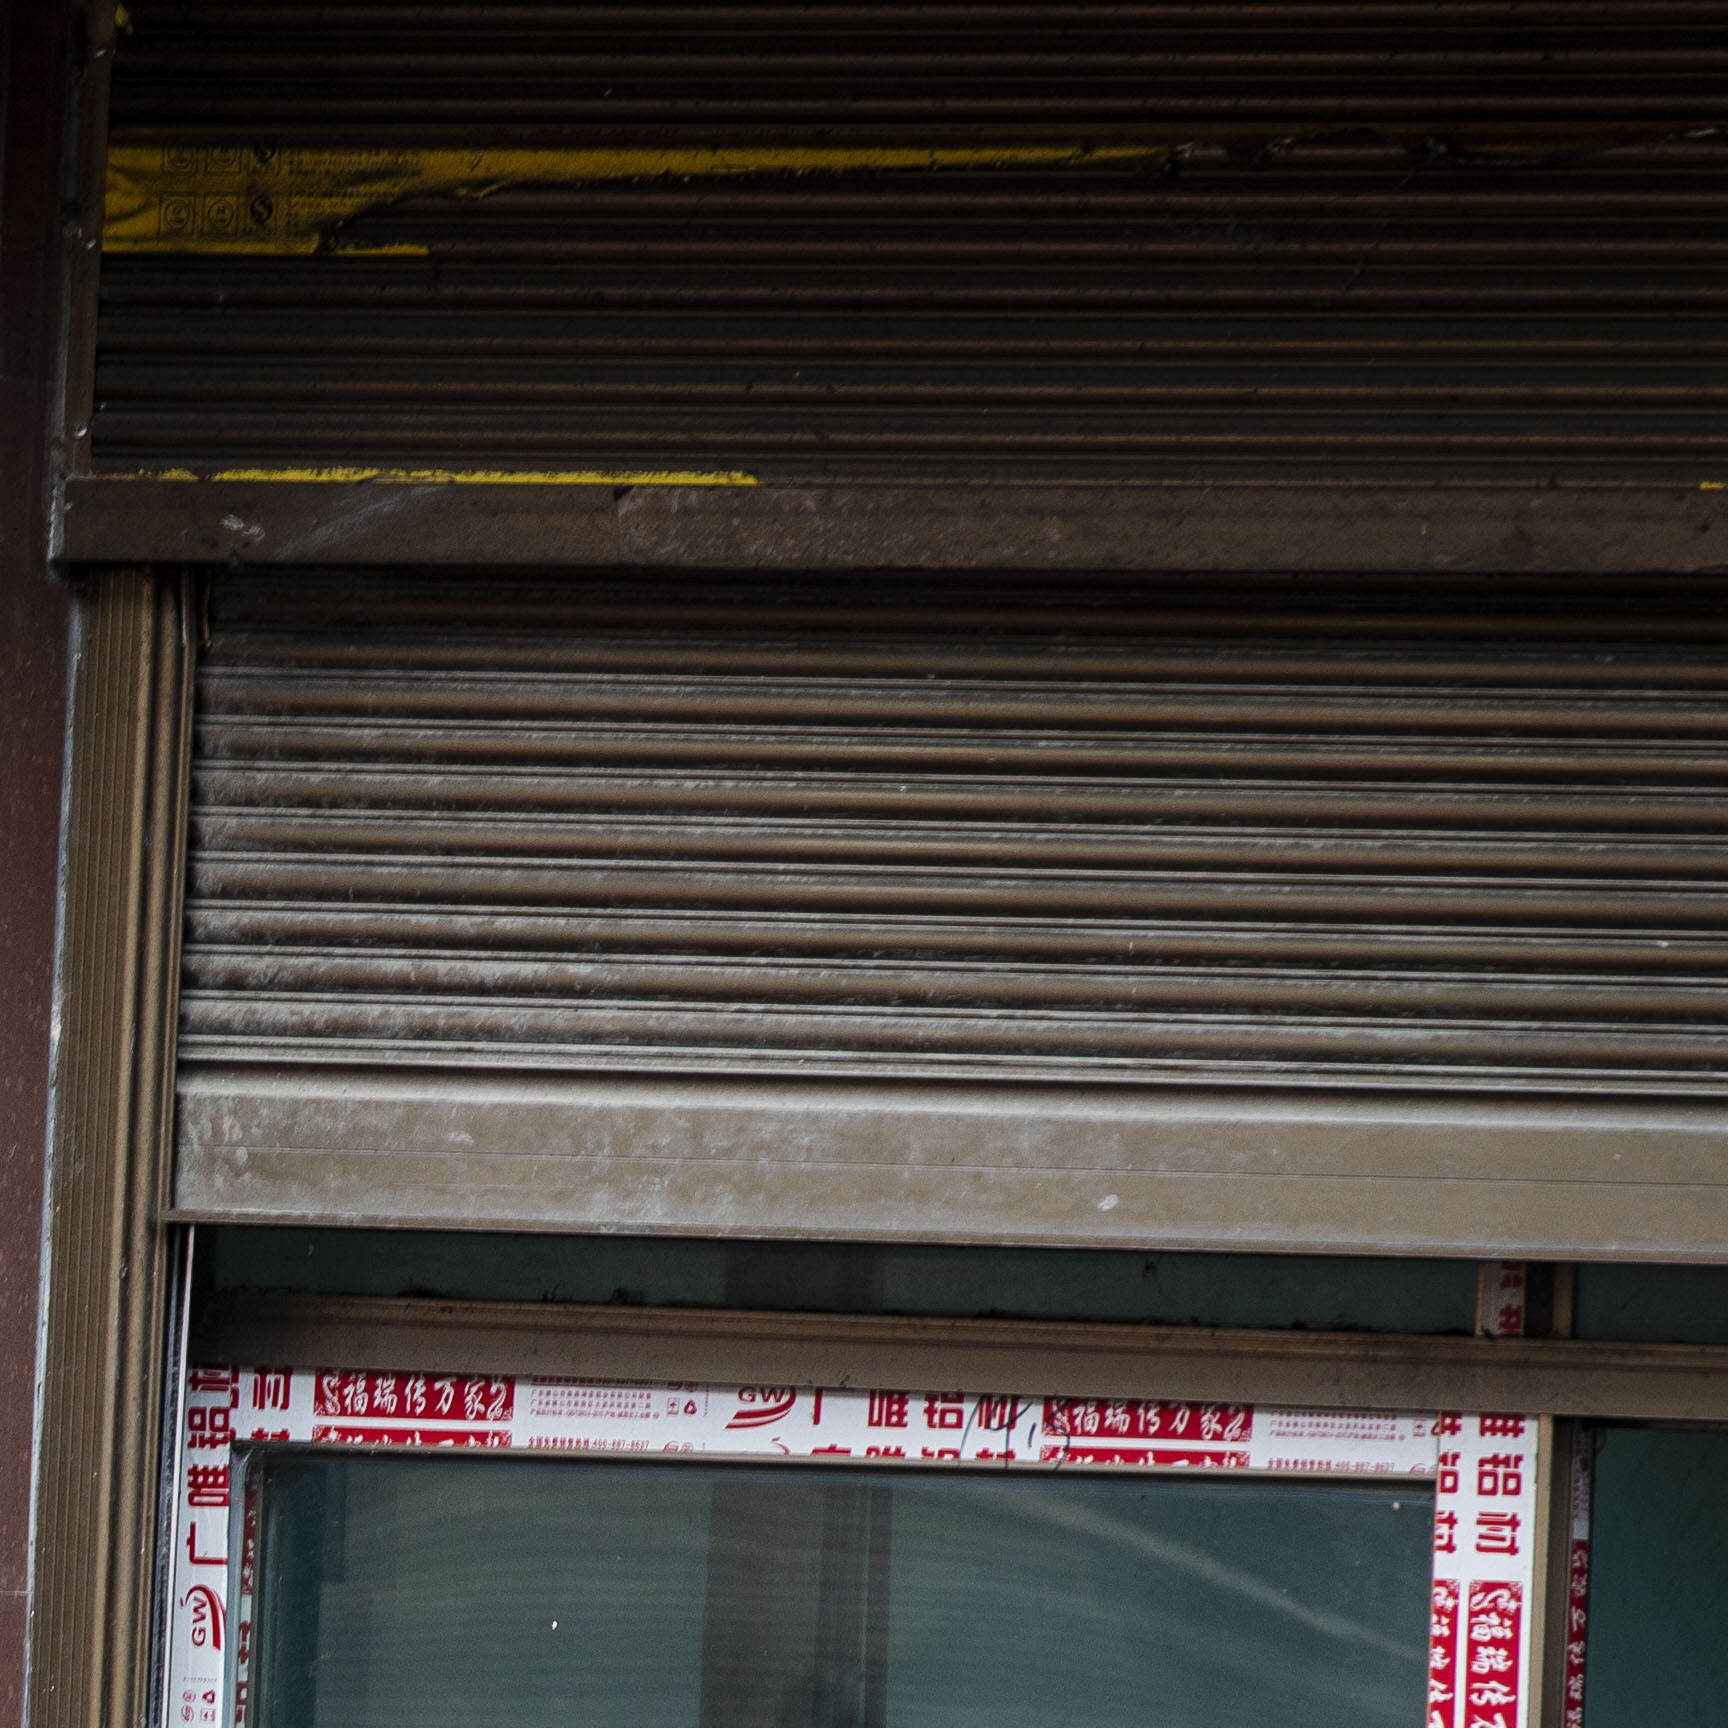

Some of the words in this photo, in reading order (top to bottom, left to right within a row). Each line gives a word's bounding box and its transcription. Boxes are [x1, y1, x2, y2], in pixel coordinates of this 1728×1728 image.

[343, 1375, 486, 1420] 福瑞传万家
[738, 1386, 785, 1404] GW
[191, 1597, 208, 1647] GW
